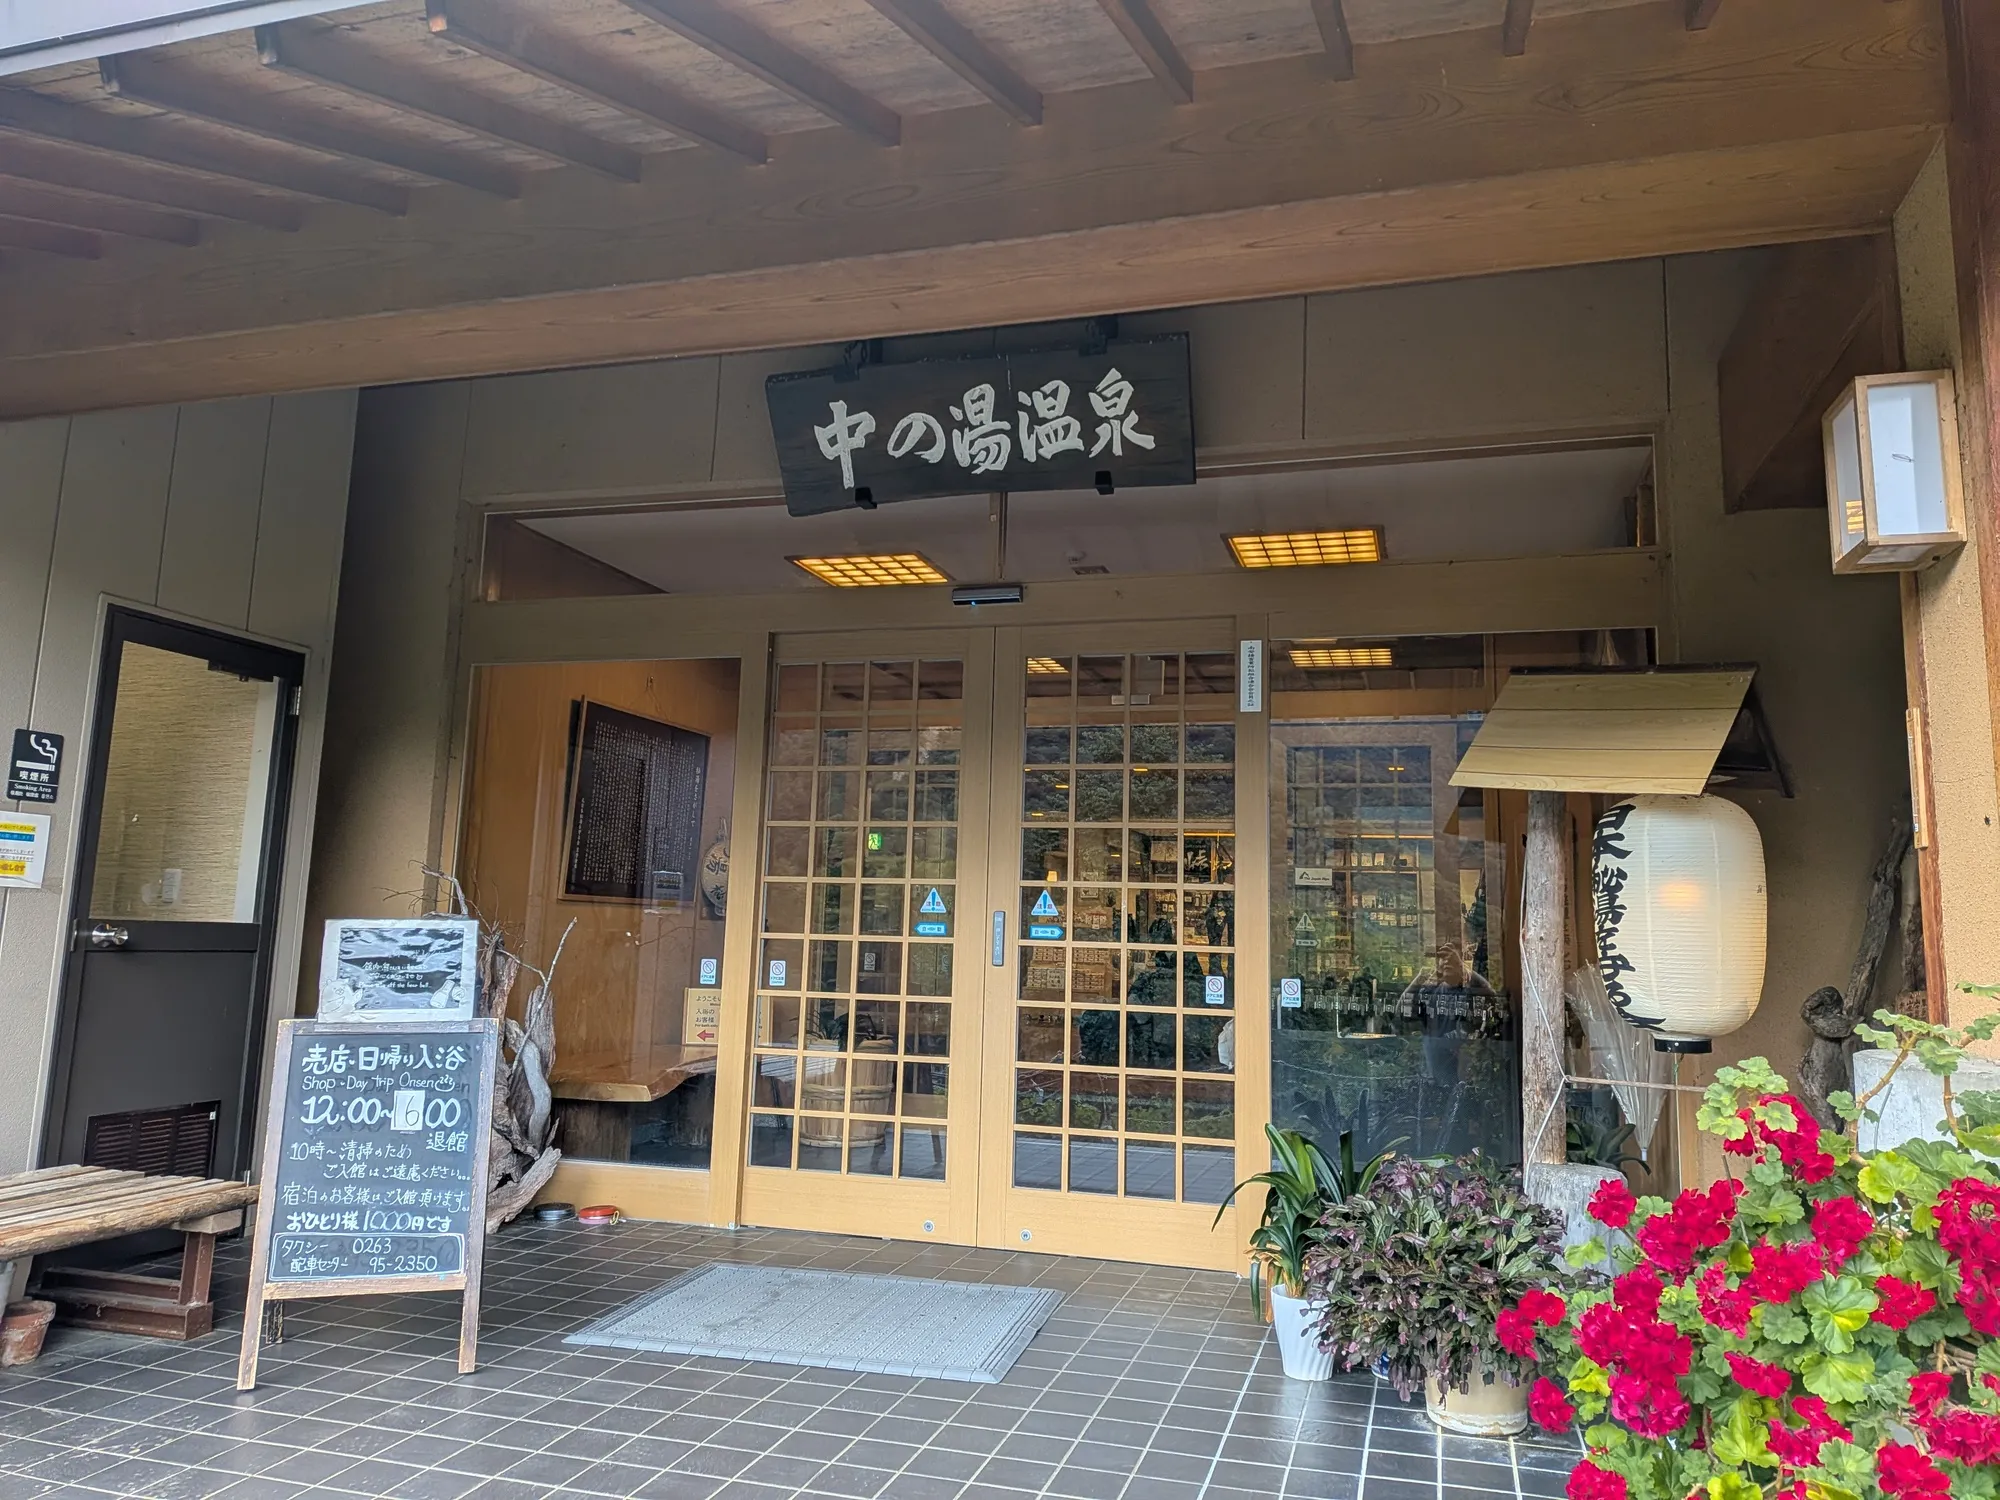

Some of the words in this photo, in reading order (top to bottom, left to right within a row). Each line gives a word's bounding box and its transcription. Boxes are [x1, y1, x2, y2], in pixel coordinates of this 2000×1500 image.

[814, 367, 1156, 490] 中の湯温泉
[19, 770, 50, 783] 喫煙所
[14, 783, 38, 792] Smoking
[38, 785, 52, 793] Area
[302, 1075, 336, 1093] Shop
[347, 1075, 368, 1092] Day
[371, 1074, 394, 1092] trip
[399, 1071, 434, 1088] Onsen
[425, 1131, 469, 1152] 退館
[286, 1210, 452, 1233] おひとり様1000円です
[281, 1239, 329, 1257] タクシー
[352, 1237, 392, 1255] 0263
[289, 1255, 349, 1276] 配車センター
[369, 1255, 438, 1274] 95-2350
